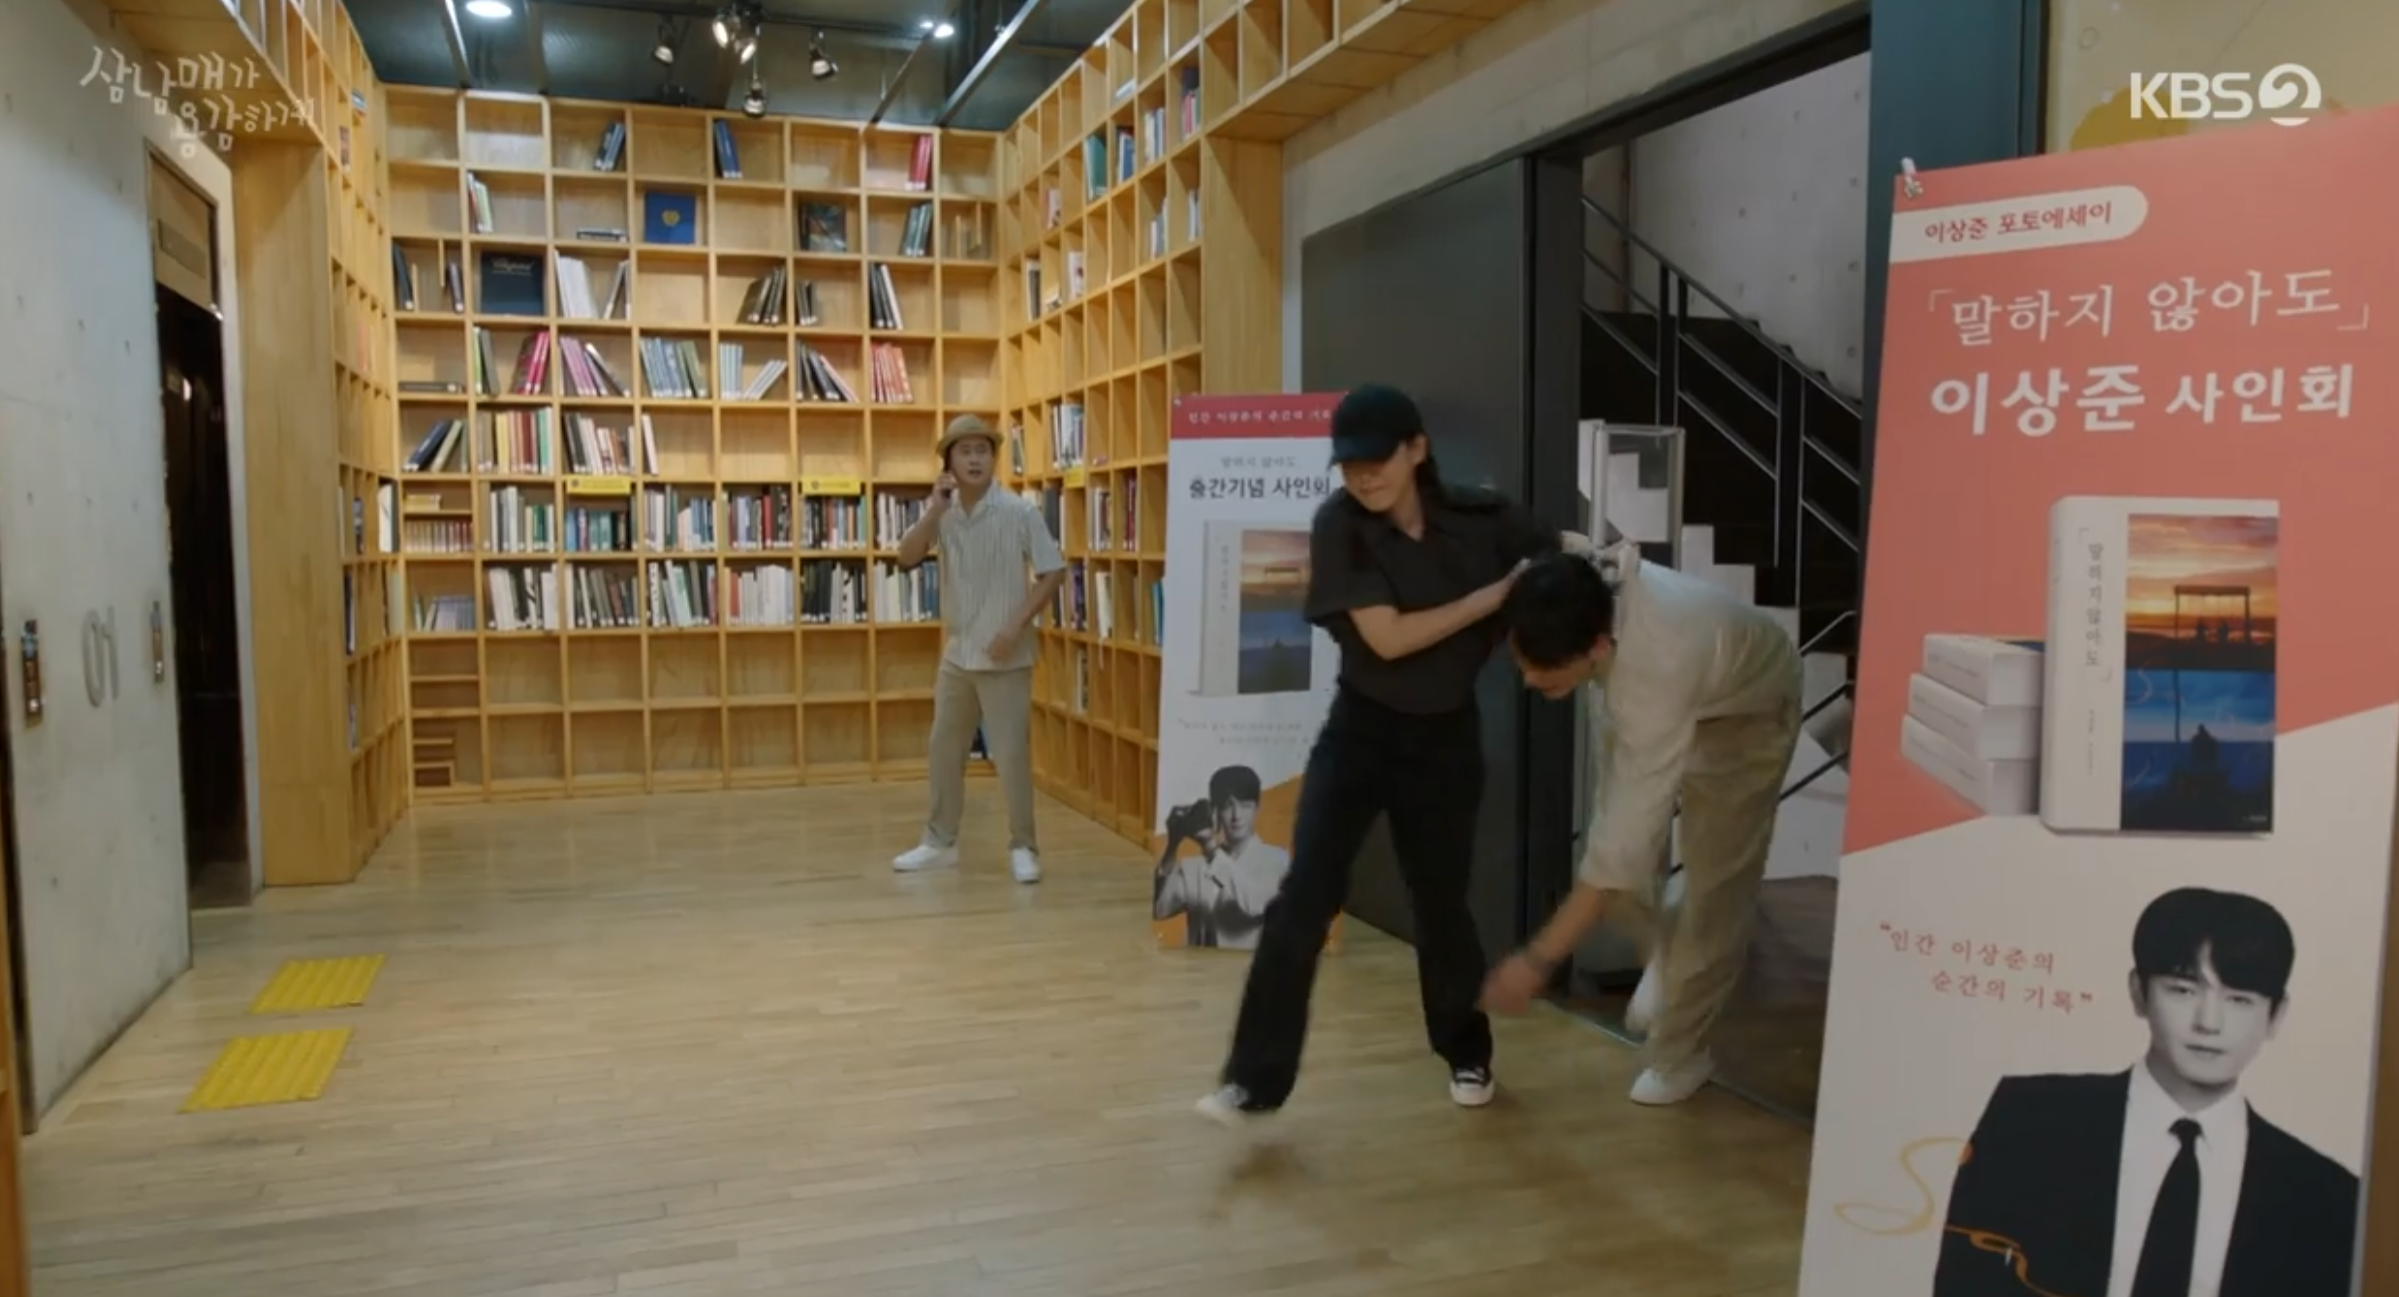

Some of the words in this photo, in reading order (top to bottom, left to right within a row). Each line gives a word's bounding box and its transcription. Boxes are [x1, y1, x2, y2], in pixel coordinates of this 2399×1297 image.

[1924, 218, 1989, 243] 이상준
[1996, 202, 2113, 234] 포토에세이
[1930, 364, 2146, 437] 이상준
[2164, 363, 2354, 425] 사인회
[1189, 477, 1265, 499] 출간기념
[1952, 938, 2054, 976] 이상준의
[1931, 970, 2006, 1001] 순간의
